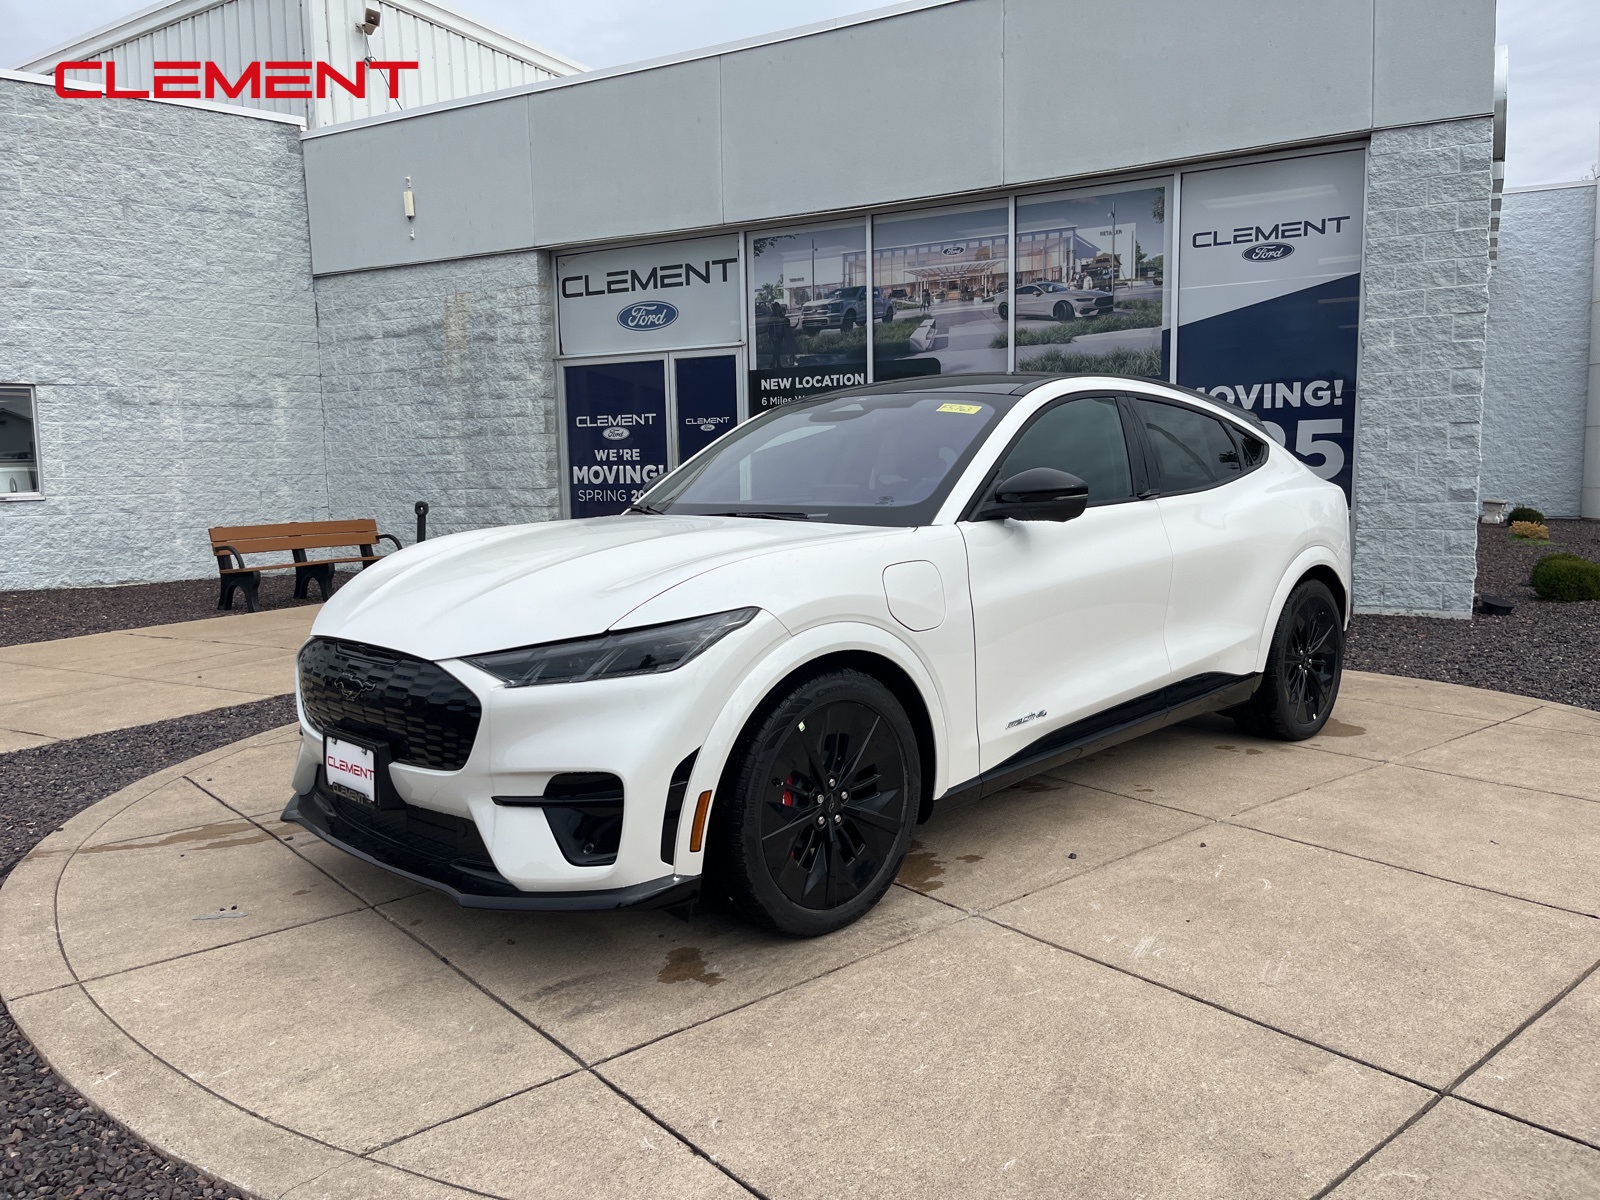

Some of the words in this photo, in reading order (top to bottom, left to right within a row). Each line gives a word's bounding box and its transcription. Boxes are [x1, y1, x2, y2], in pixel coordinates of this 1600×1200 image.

[1192, 215, 1351, 249] CLEMENT
[1252, 245, 1284, 260] Ford
[561, 257, 738, 299] CLEMENT
[628, 305, 667, 327] Ford
[761, 377, 792, 391] NEW
[795, 372, 865, 389] LOCATION
[761, 397, 768, 406] 6
[576, 413, 656, 428] CLEMENT
[685, 416, 730, 425] CLEMENT
[594, 448, 641, 462] WE'RE
[578, 489, 627, 502] SPRING
[327, 755, 375, 780] CLEMENT
[333, 783, 366, 804] CLEMENT
